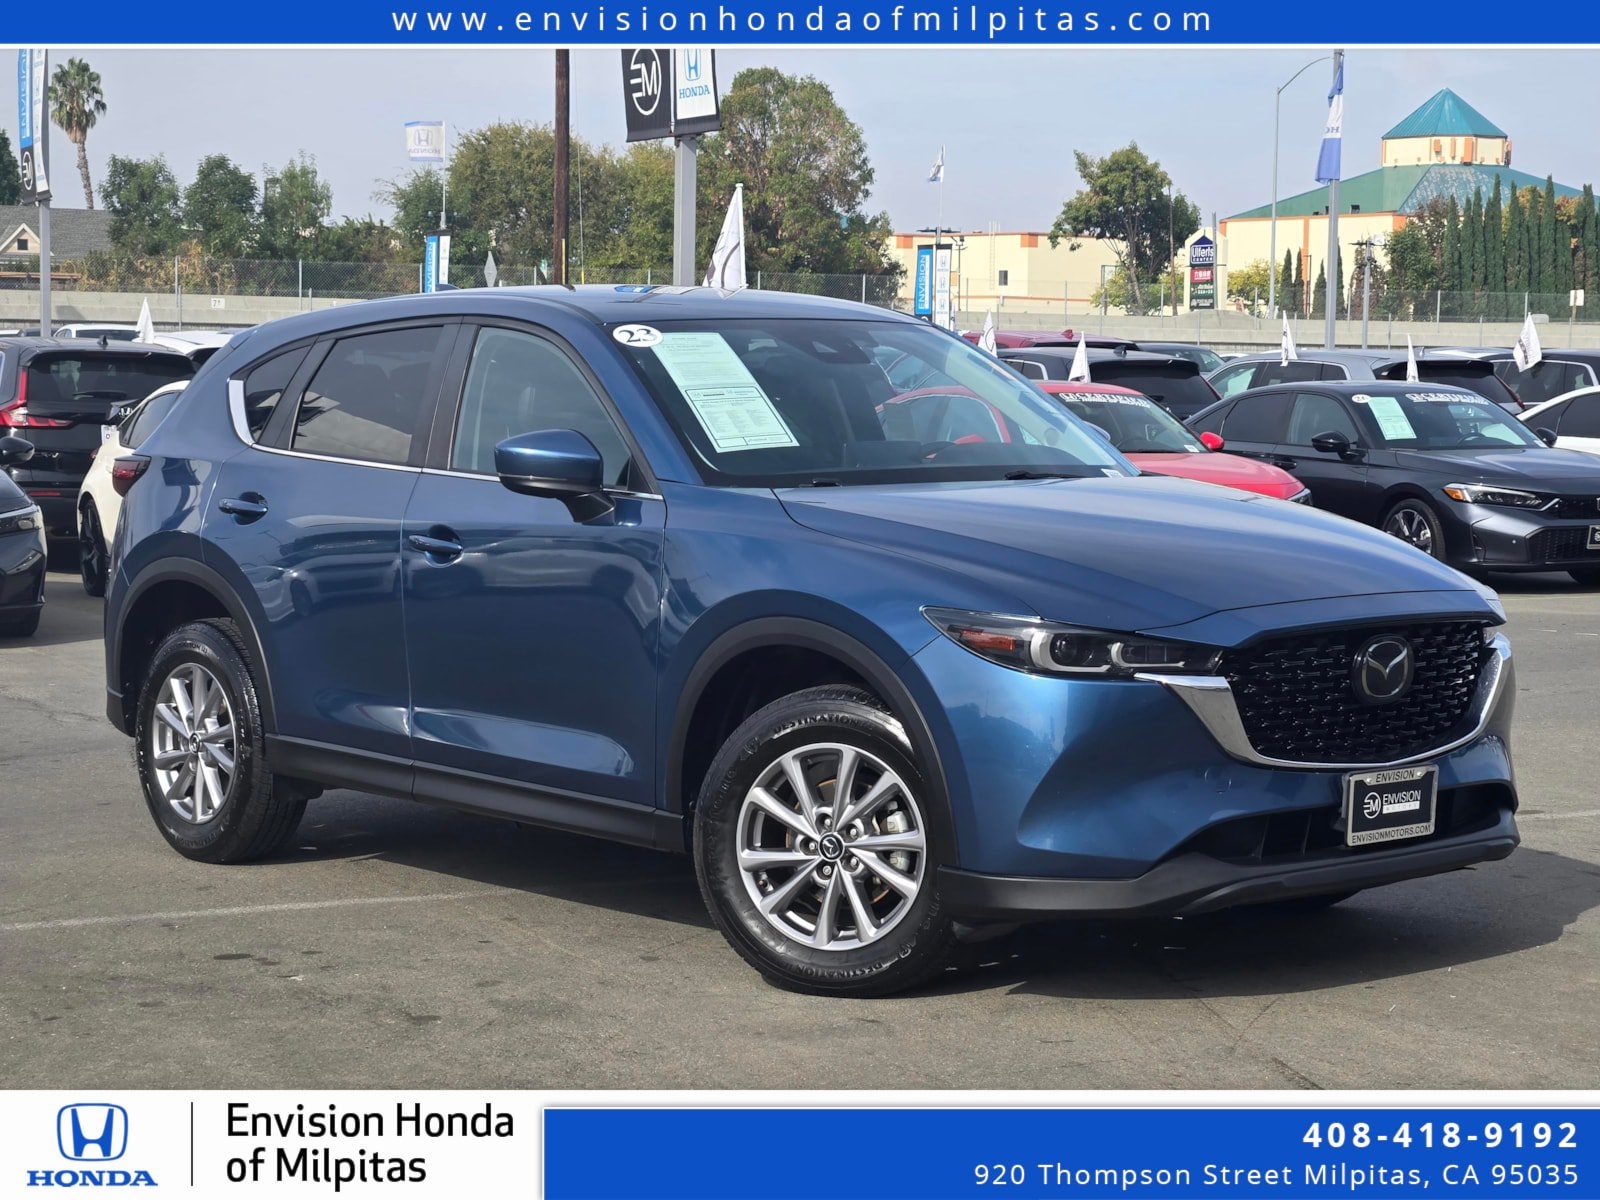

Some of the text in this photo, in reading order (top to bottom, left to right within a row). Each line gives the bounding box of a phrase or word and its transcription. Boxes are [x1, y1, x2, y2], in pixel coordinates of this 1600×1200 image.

[679, 85, 710, 99] HONDA
[918, 255, 926, 309] ENVISION
[618, 328, 657, 343] 23
[1376, 769, 1415, 783] ENVISION
[1382, 790, 1421, 805] ENVISION
[1351, 825, 1431, 844] ENVISIONMOTORS.COM
